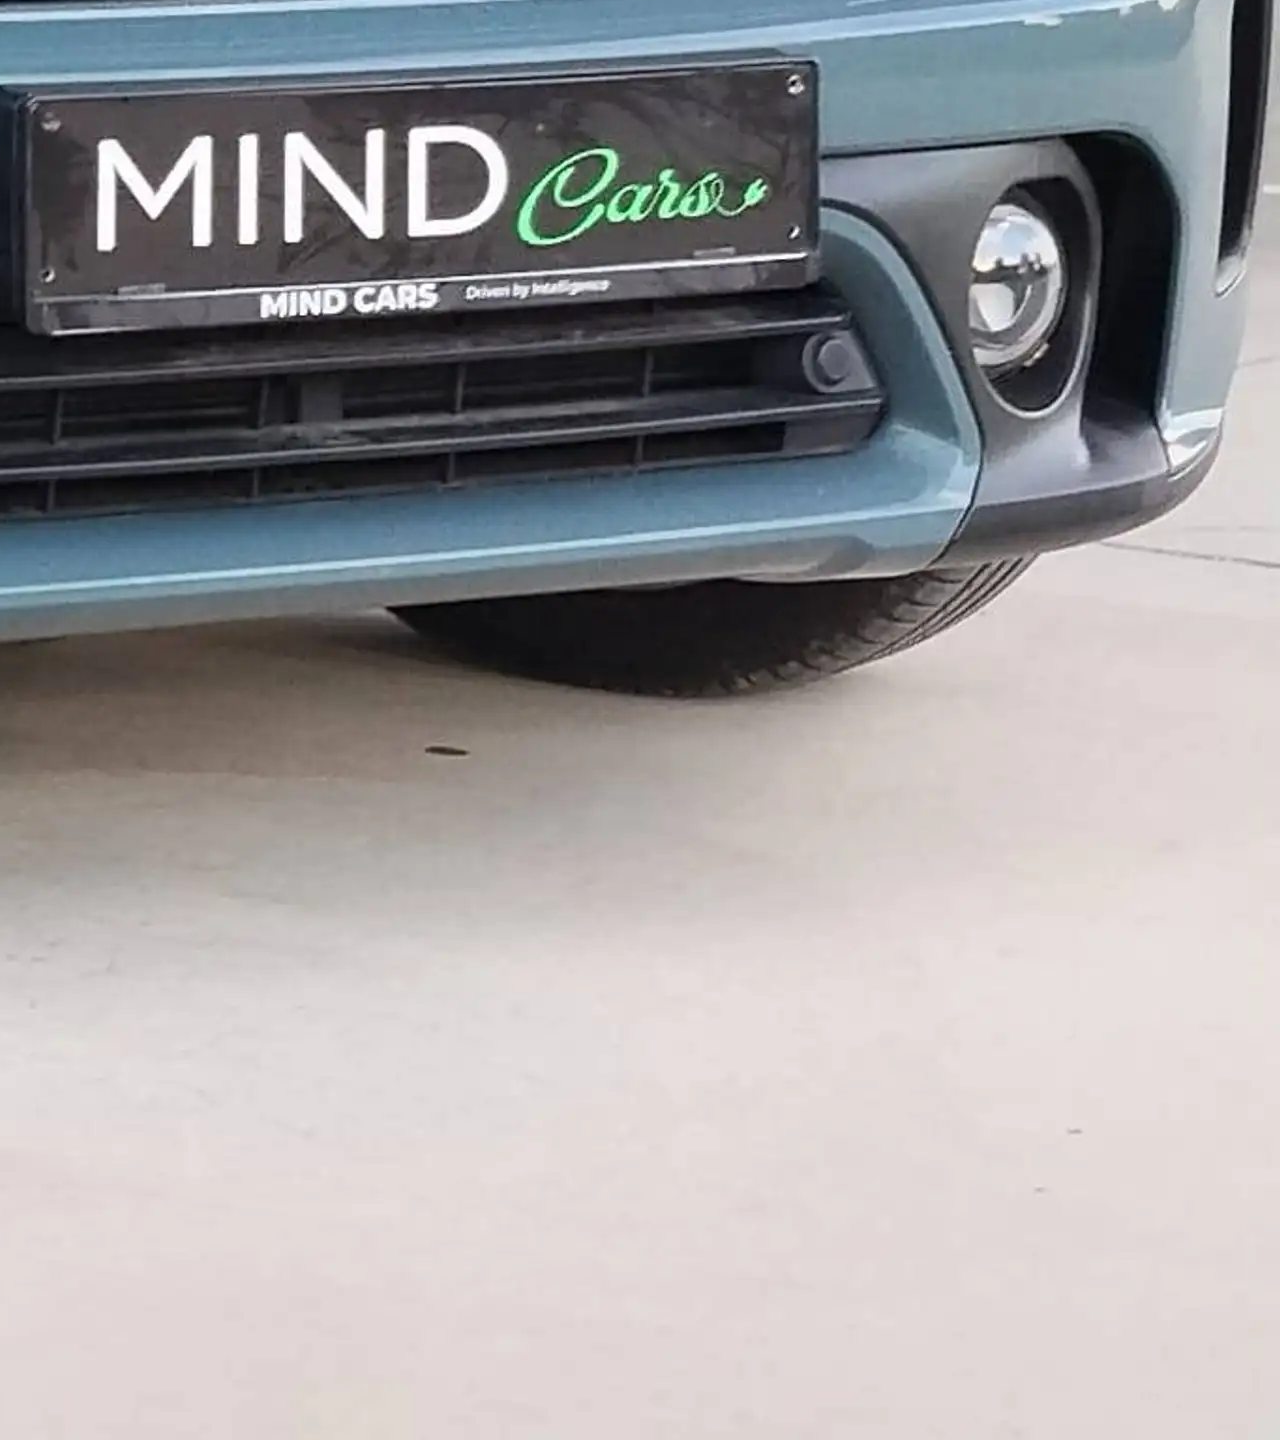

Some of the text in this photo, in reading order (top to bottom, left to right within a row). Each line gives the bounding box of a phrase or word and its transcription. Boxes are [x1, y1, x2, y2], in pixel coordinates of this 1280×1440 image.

[96, 125, 740, 252] MIND Cars
[259, 282, 439, 319] MIND CARS
[465, 283, 510, 301] Driven
[513, 282, 530, 300] by
